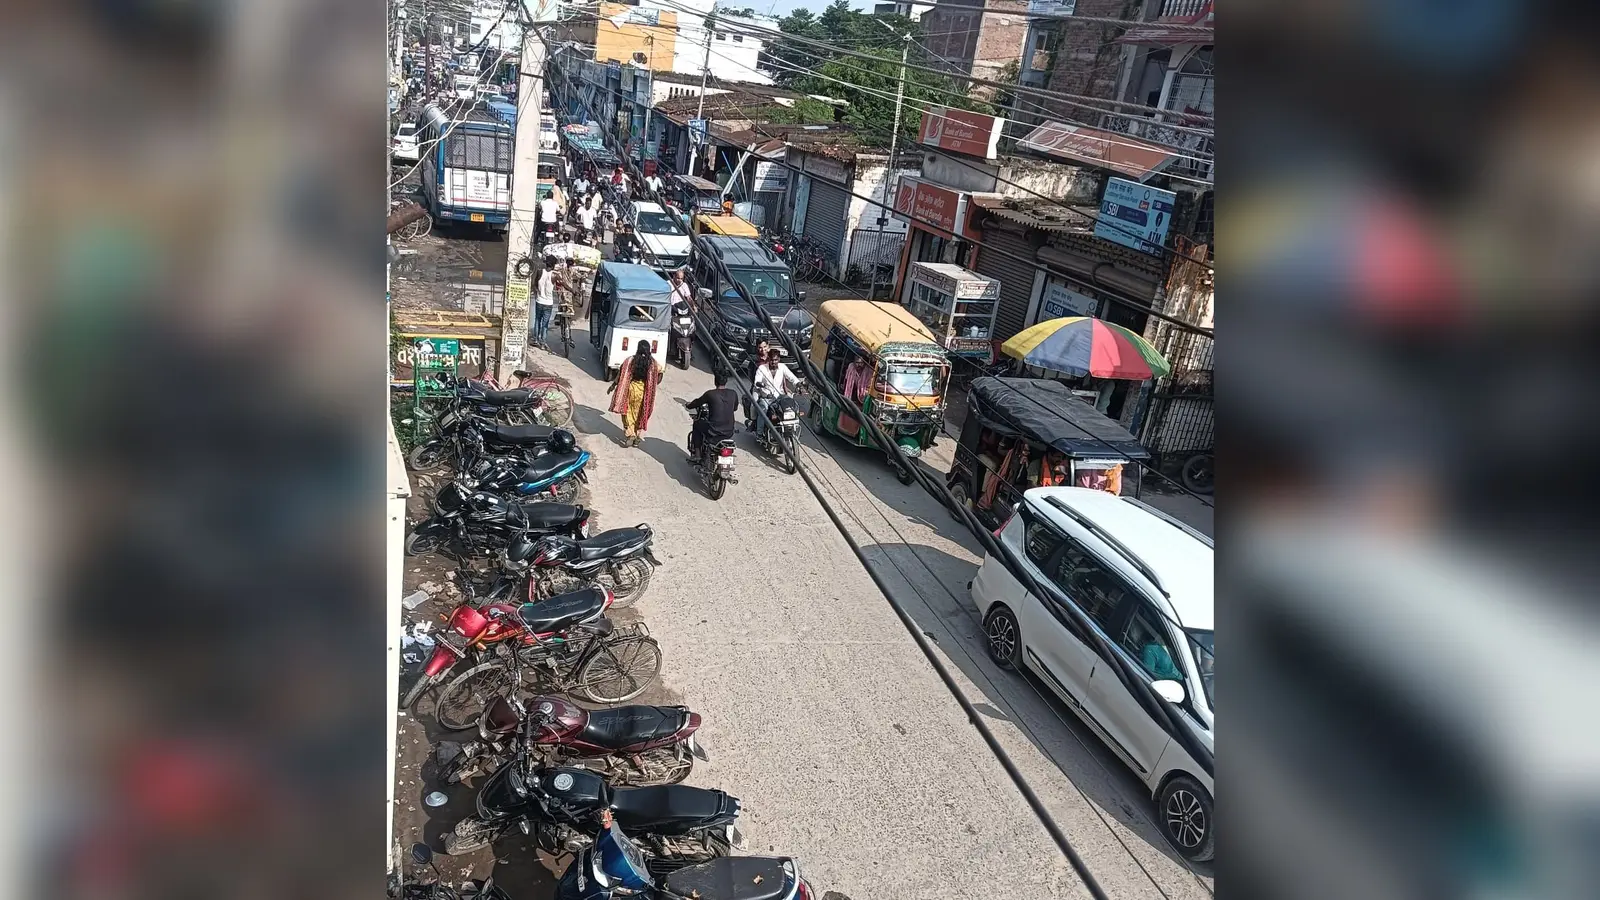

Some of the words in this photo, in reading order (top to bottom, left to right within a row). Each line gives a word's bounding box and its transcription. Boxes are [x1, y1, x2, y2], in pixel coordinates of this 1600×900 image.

[951, 140, 962, 148] ATM
[1107, 202, 1120, 217] SBI
[1147, 230, 1162, 245] ATM
[1052, 304, 1064, 317] SBI
